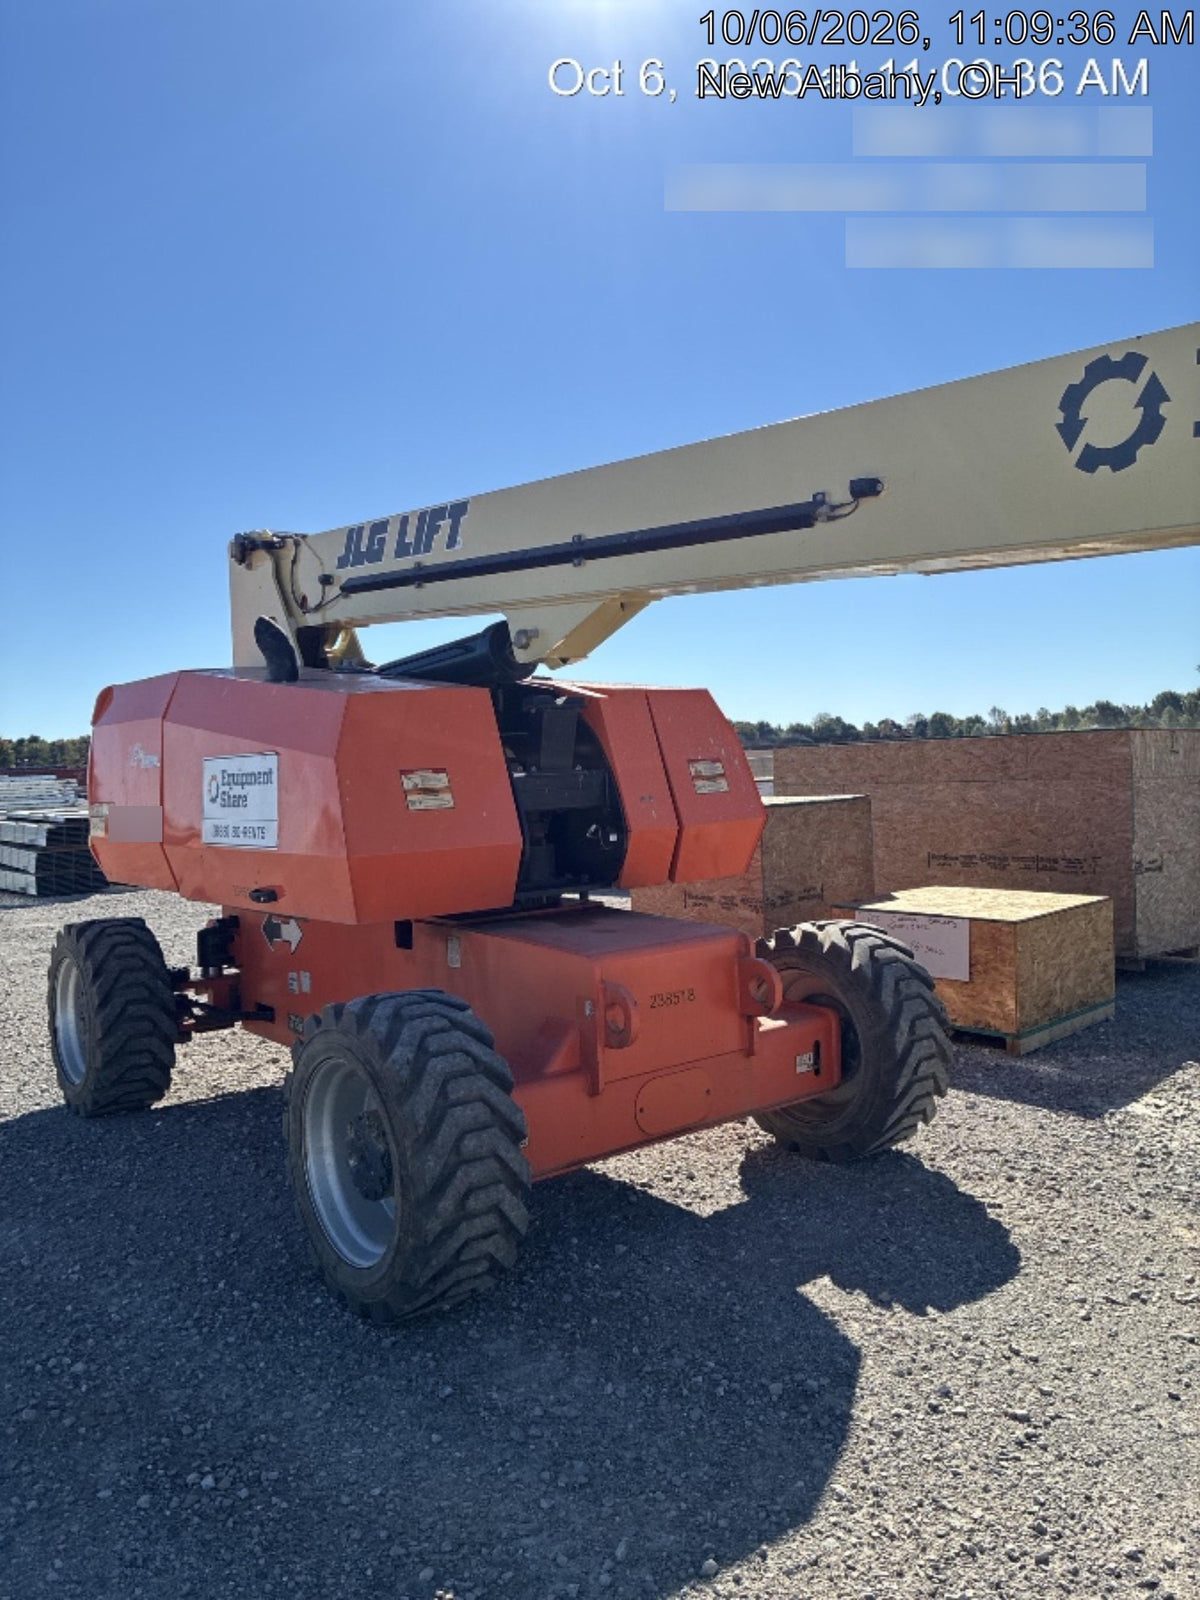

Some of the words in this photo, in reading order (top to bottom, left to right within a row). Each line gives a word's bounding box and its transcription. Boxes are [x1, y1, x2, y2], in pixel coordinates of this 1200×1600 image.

[336, 518, 390, 569] JLG
[394, 500, 469, 559] LIFT
[220, 768, 274, 790] Equipment
[220, 790, 248, 808] Share
